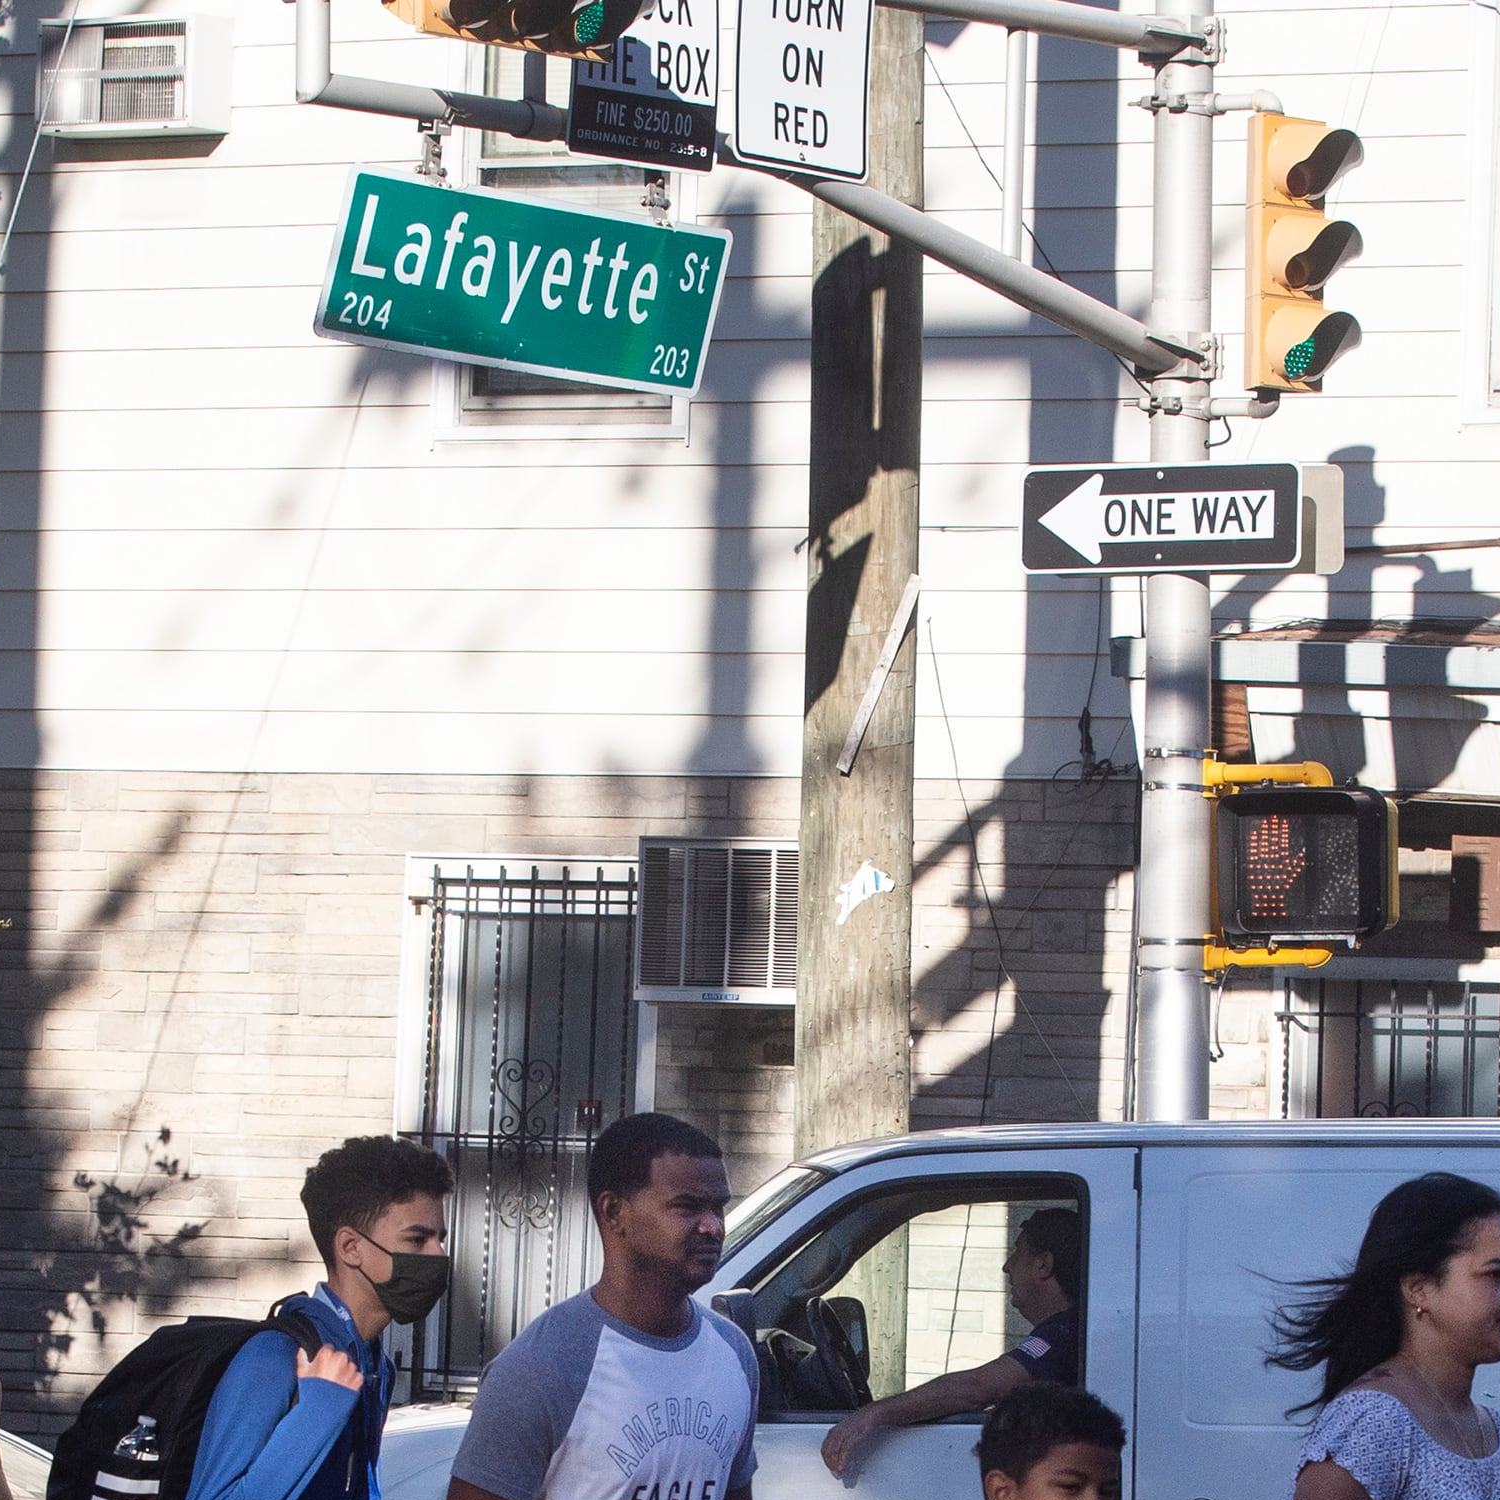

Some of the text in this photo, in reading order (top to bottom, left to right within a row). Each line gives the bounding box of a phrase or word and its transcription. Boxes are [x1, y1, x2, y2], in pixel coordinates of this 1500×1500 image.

[656, 41, 710, 98] BOX
[782, 43, 824, 88] ON
[596, 101, 693, 138] FINE $250.00
[773, 102, 829, 149] RED
[576, 128, 639, 148] ORDINANCE
[669, 142, 709, 158] 23:5-8
[350, 194, 711, 324] Lafayette St
[338, 291, 393, 330] 204
[649, 344, 691, 379] 203
[1103, 495, 1268, 537] ONE WAY
